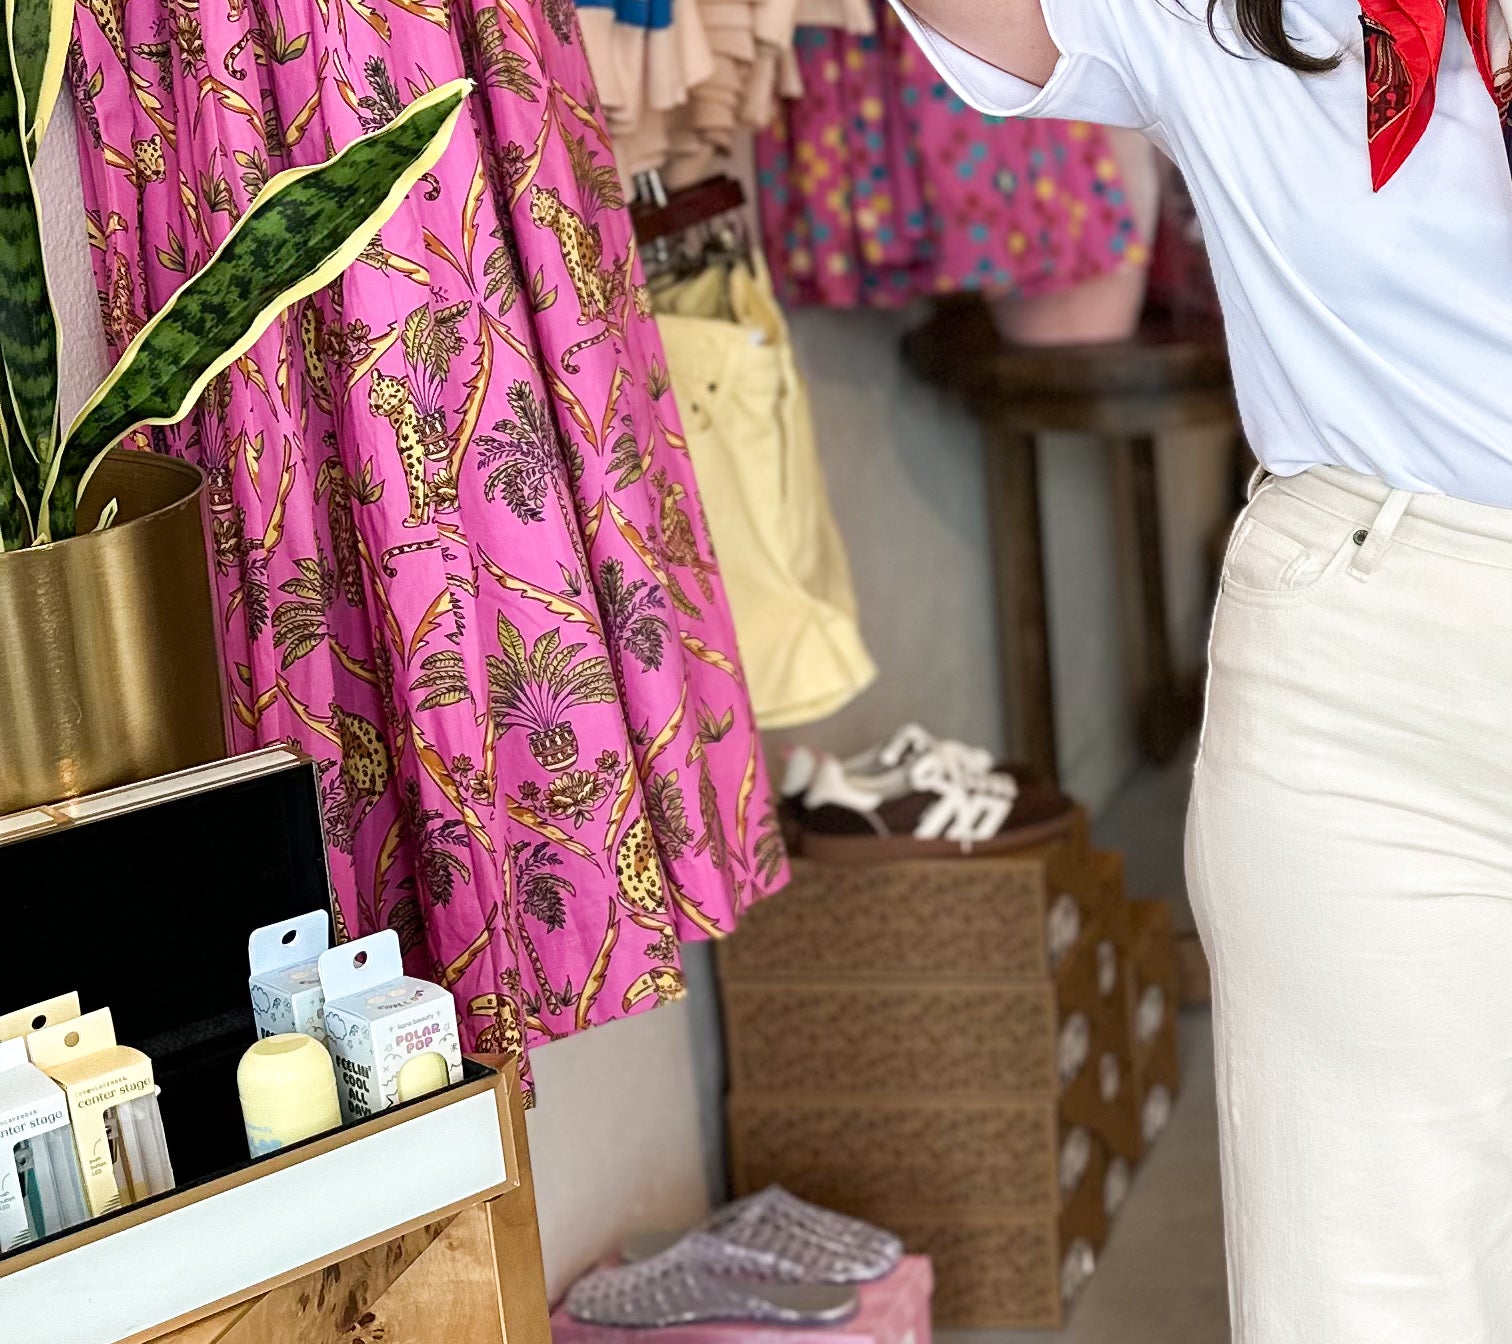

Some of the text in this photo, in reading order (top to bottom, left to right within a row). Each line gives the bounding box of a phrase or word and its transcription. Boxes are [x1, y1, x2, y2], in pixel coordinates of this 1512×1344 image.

[395, 1022, 441, 1047] POLAR
[406, 1036, 434, 1054] POP
[77, 1077, 151, 1109] center stage
[342, 1071, 370, 1093] COOL
[348, 1087, 369, 1106] ALL
[0, 1110, 63, 1139] nter stage
